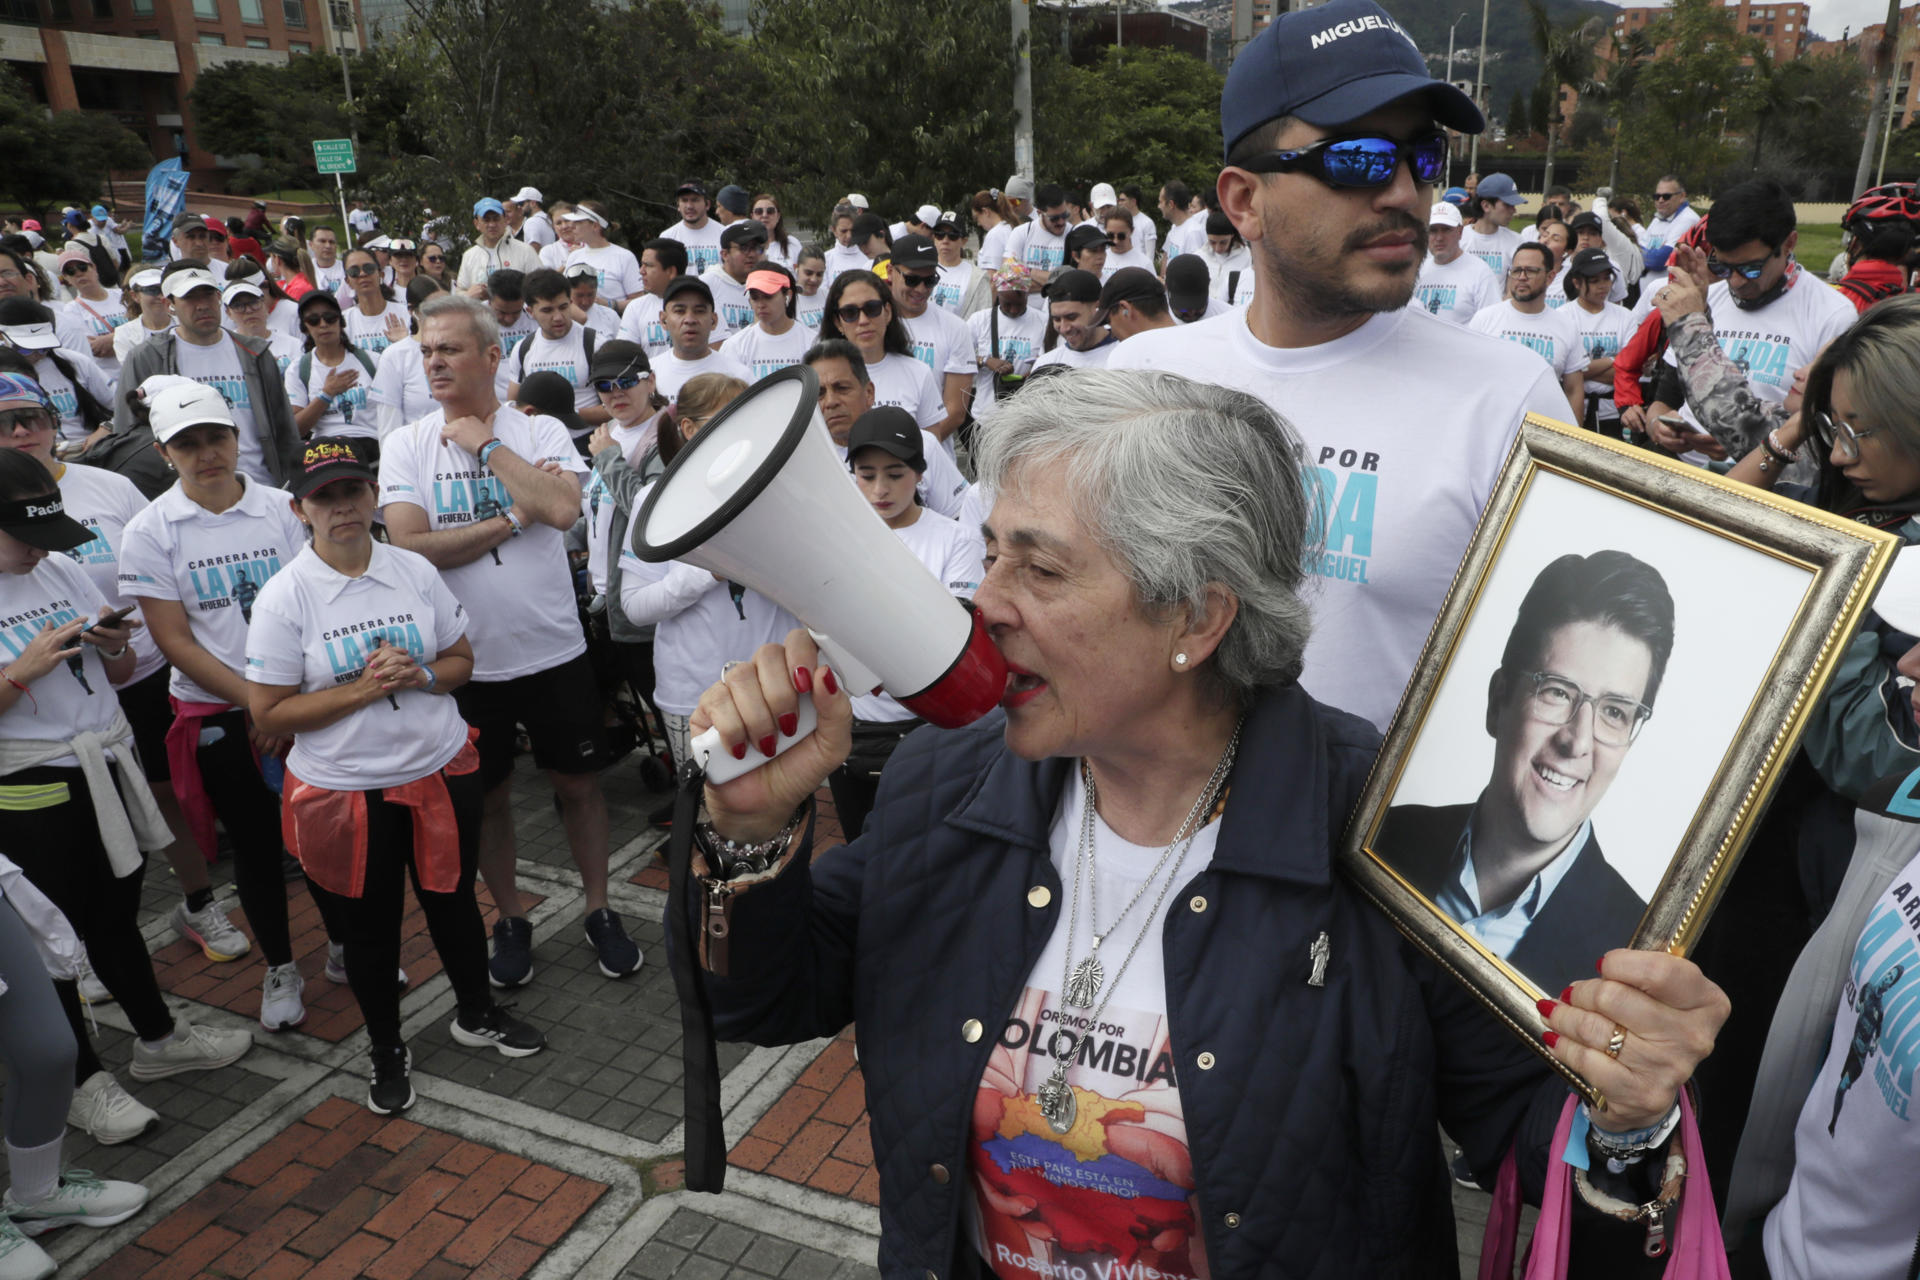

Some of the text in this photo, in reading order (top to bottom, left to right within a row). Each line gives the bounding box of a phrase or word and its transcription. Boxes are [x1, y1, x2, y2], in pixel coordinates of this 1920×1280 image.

[1310, 15, 1389, 49] MIGUEL
[1715, 330, 1791, 345] ARRERA POR
[913, 346, 934, 369] DA
[1318, 446, 1380, 472] POR
[436, 470, 495, 481] CARRERA
[433, 480, 469, 513] LA
[80, 518, 98, 527] OR
[437, 512, 473, 524] #FUERZA
[1300, 465, 1378, 558] DA
[188, 547, 278, 570] CARRERA POR
[190, 566, 229, 601] LA
[0, 607, 49, 628] ARRERA
[198, 597, 232, 612] #FUERZA
[323, 613, 414, 641] CARRERA POR
[324, 635, 367, 675] LA
[1040, 1009, 1125, 1038] OREMOS POR
[999, 1018, 1177, 1088] OLOMBIA
[1873, 1055, 1911, 1122] MIGUEL
[1010, 1151, 1134, 1189] ESTE PAÍS ESTÁ EN
[1090, 1183, 1140, 1199] SEÑOR
[995, 1242, 1087, 1280] Rosario
